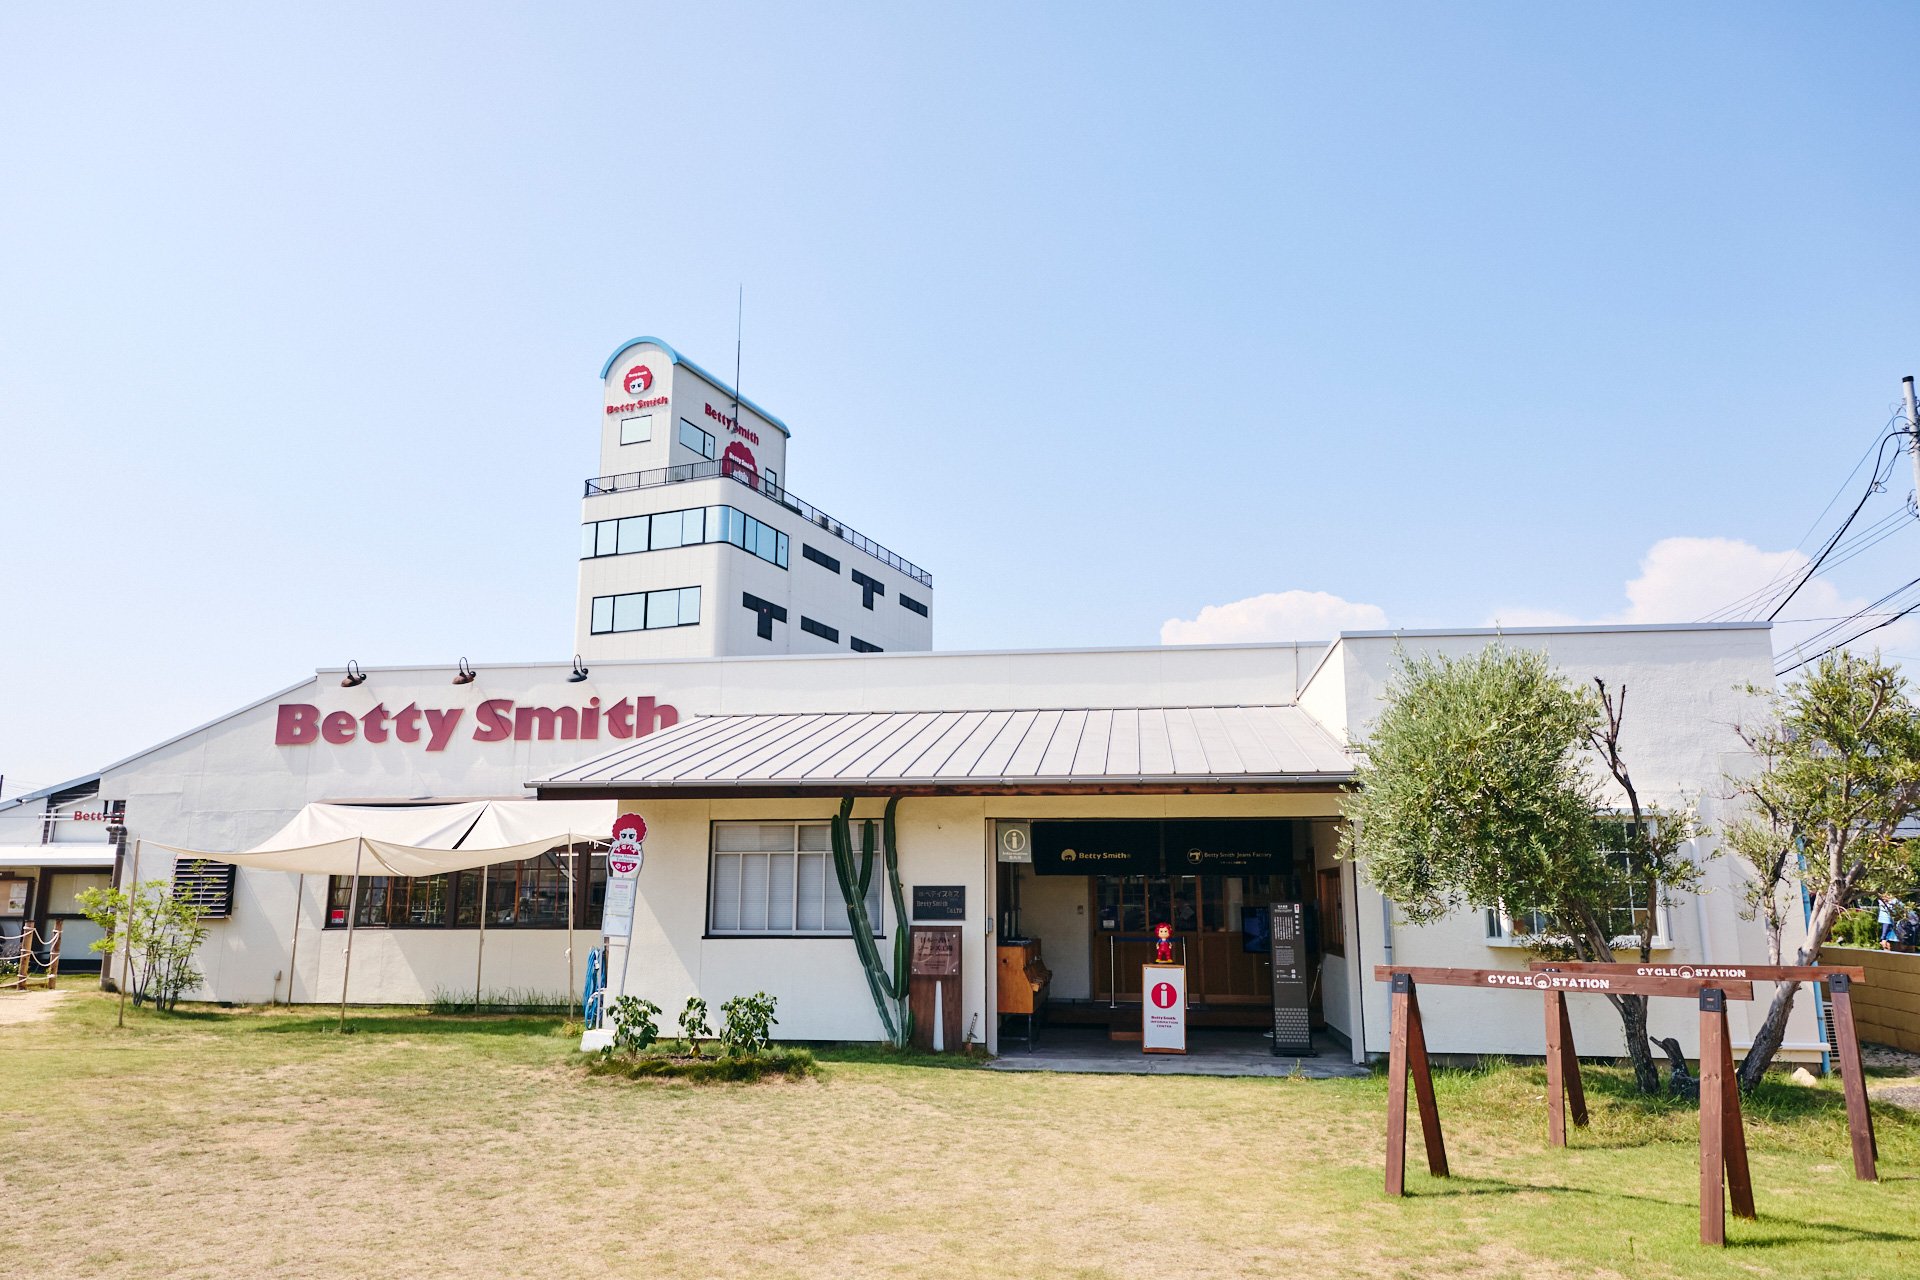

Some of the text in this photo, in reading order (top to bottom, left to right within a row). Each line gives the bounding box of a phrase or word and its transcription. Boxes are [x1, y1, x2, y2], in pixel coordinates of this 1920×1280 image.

[606, 396, 669, 415] Betty Smith
[705, 402, 759, 446] Betty Smith
[275, 696, 679, 752] Betty Smith
[1079, 852, 1101, 860] Betty
[1637, 968, 1746, 978] CYCLE STATION
[1487, 975, 1610, 989] CYCLE STATION
